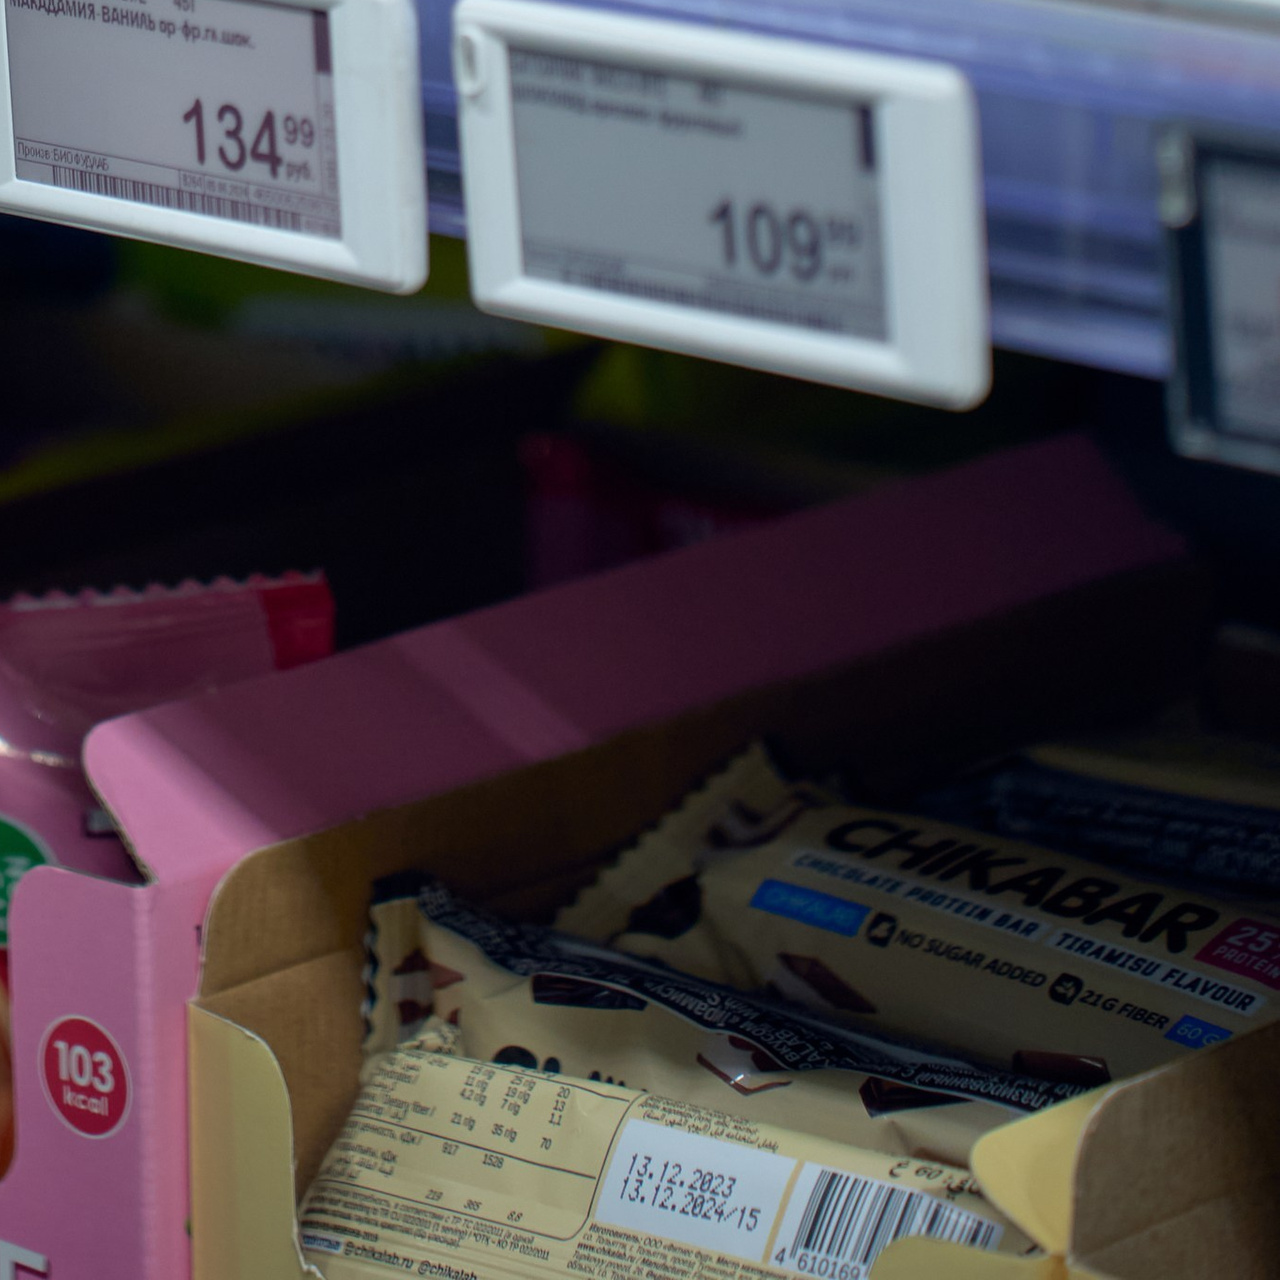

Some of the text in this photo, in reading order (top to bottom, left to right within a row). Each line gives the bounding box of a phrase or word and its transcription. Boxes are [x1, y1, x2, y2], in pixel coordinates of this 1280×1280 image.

[183, 97, 315, 181] 134 99
[709, 196, 824, 283] 109
[825, 819, 1220, 954] CHIKABAR
[793, 853, 904, 893] CHOCOLATE
[905, 886, 993, 922] PROTEIN
[993, 913, 1041, 937] BAR
[1055, 933, 1160, 977] TIRAMISU
[1161, 968, 1257, 1012] FLAVOUR
[1226, 926, 1280, 970] 25
[895, 928, 1171, 1031] NO SUGAR ADDED 21G FIBER
[53, 1040, 116, 1094] 103
[62, 1085, 110, 1118] kcal
[505, 1085, 519, 1099] 19
[552, 1098, 566, 1112] 13
[557, 1086, 571, 1099] 20
[491, 1122, 504, 1137] 35
[540, 1136, 552, 1150] 70
[481, 1153, 505, 1169] 1528
[628, 1153, 738, 1198] 13.12.2023
[620, 1176, 762, 1233] 13.12.2024/15
[343, 1241, 478, 1280] @chikalab.ru @chikalab
[519, 1244, 550, 1261] 022/2011
[643, 1237, 663, 1249] ООО
[775, 1246, 862, 1280] 4 610169
